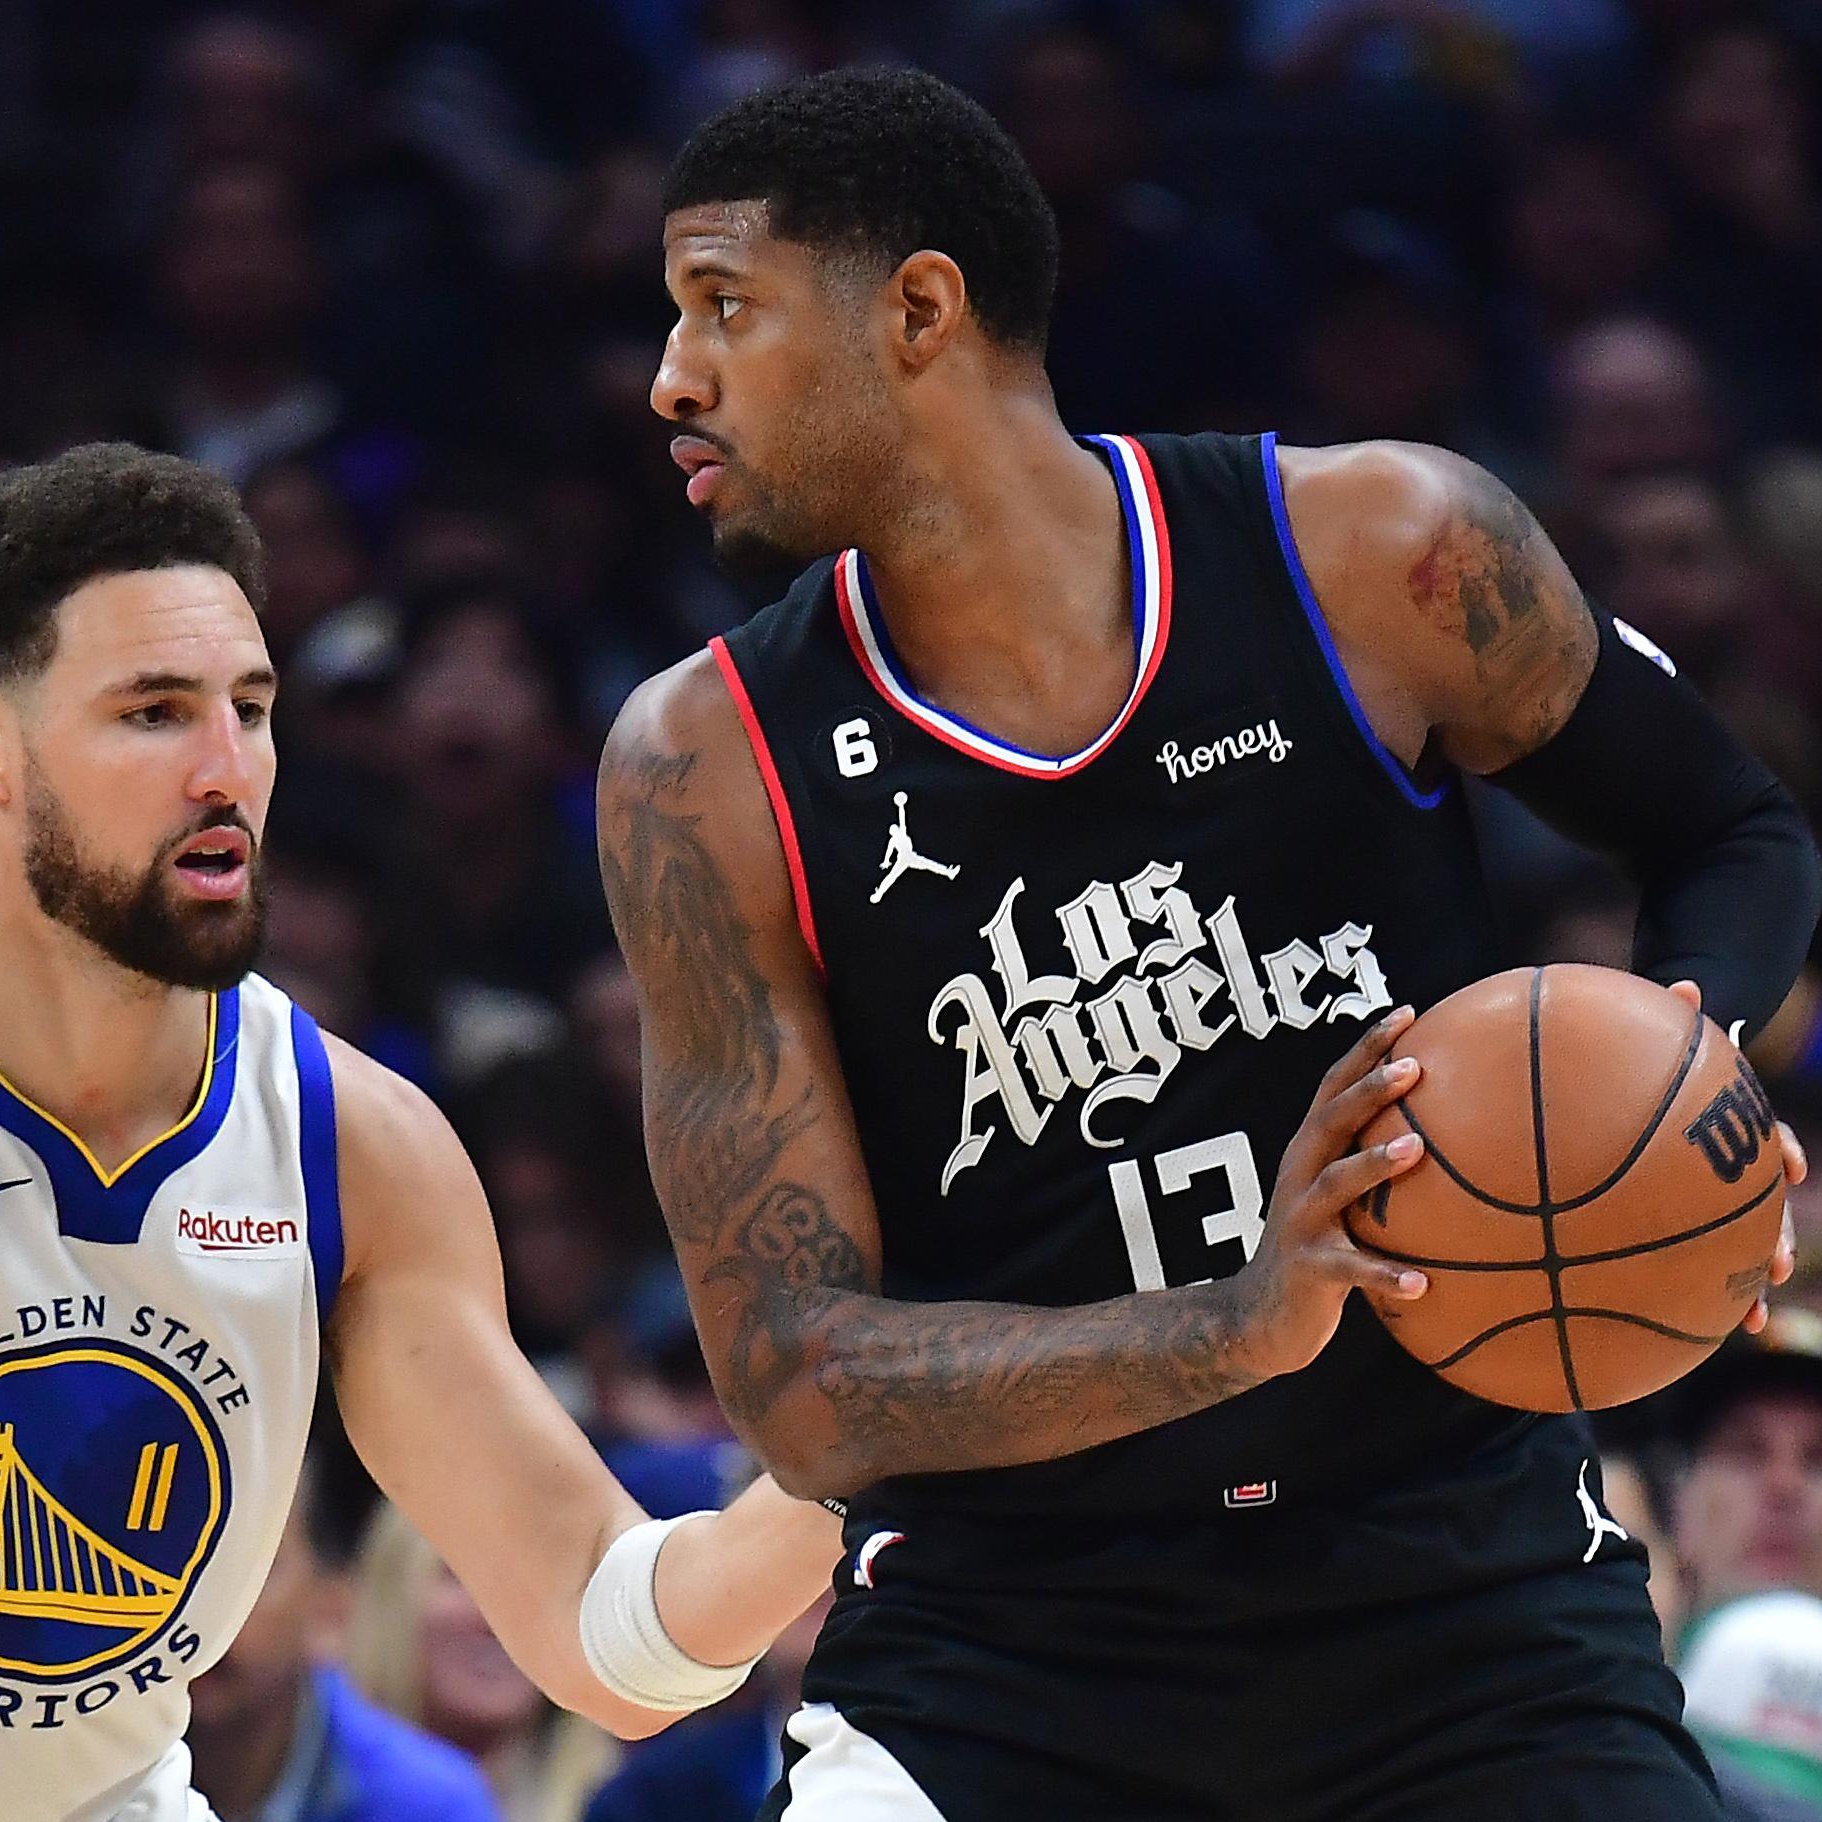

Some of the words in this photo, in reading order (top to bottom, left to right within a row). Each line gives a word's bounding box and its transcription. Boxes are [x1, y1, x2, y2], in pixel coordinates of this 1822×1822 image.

[832, 717, 878, 778] 6
[1156, 719, 1293, 784] honey
[979, 860, 1212, 1026] Los
[928, 895, 1393, 1197] Angeles
[178, 1208, 299, 1245] Rakuten
[1108, 1130, 1267, 1292] 13
[130, 1306, 251, 1416] STATE
[126, 1441, 179, 1532] 11
